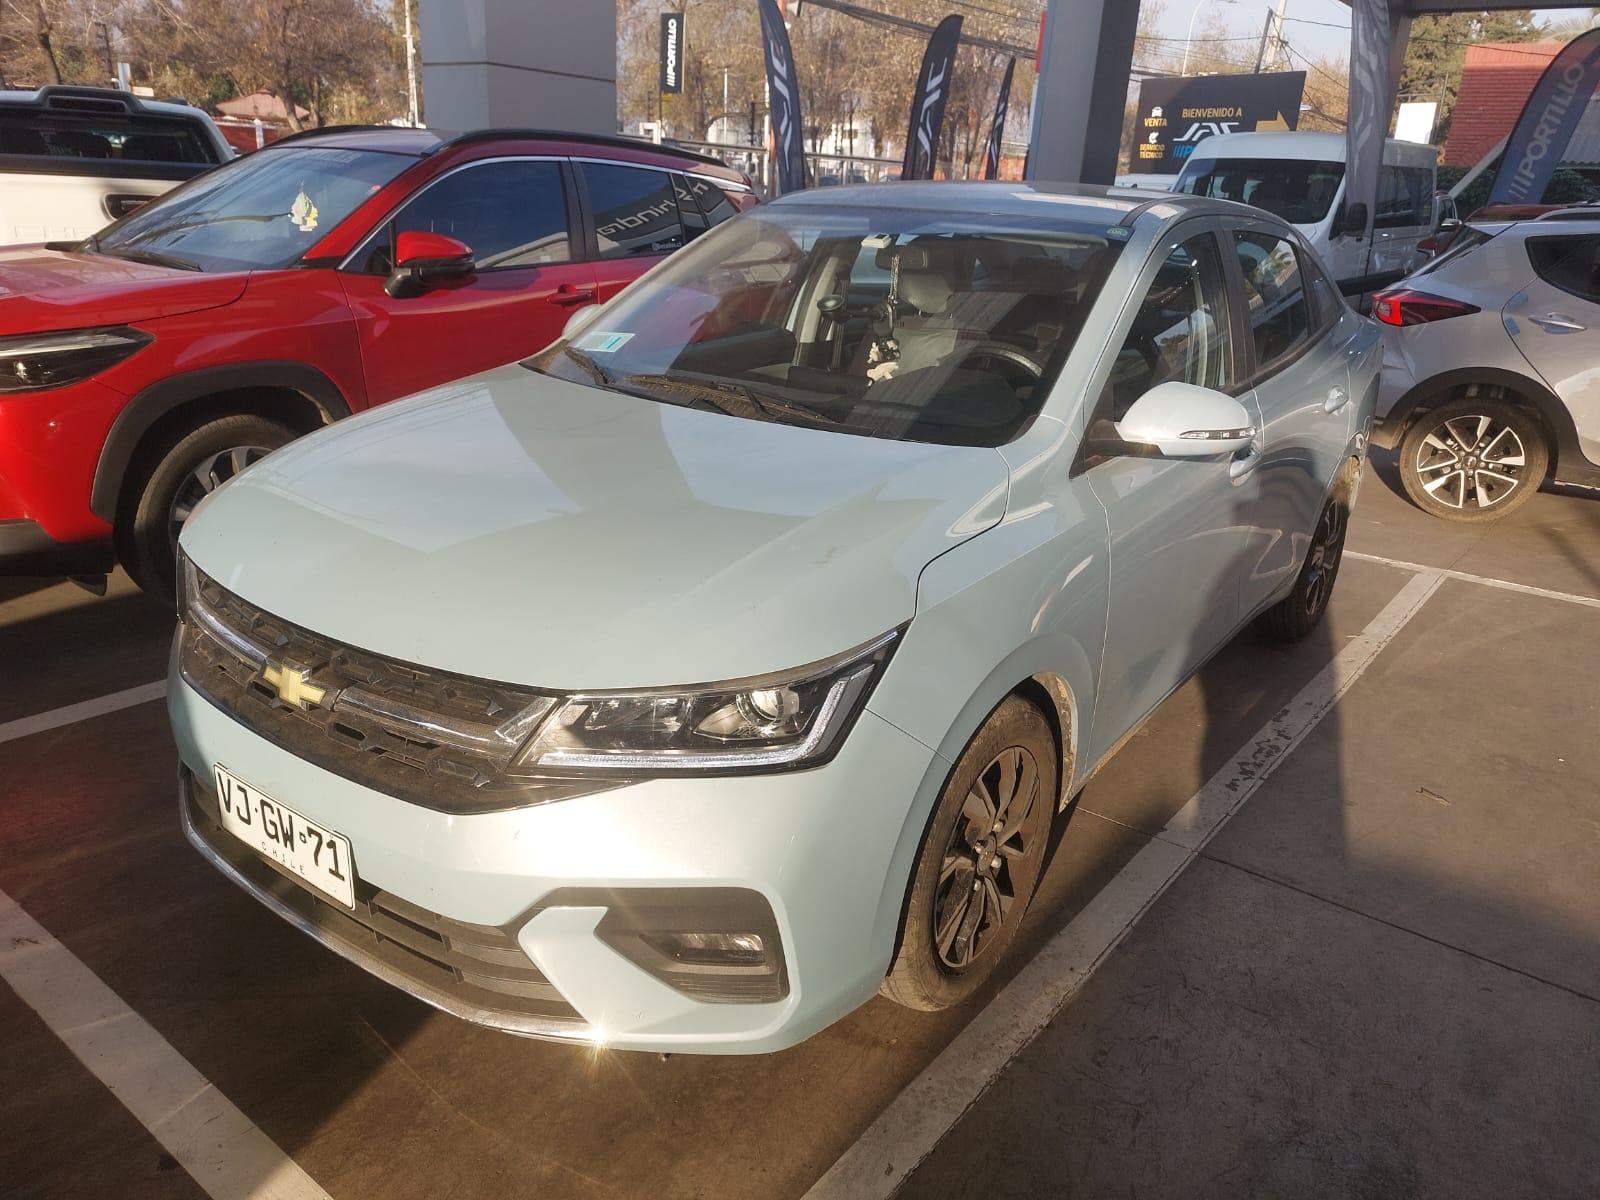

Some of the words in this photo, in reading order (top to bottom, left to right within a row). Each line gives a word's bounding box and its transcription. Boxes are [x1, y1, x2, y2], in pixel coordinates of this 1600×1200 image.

[1182, 108, 1233, 118] BIENVENIDO
[1235, 108, 1243, 117] A
[1144, 118, 1168, 127] VENTA
[261, 841, 307, 876] CHILE
